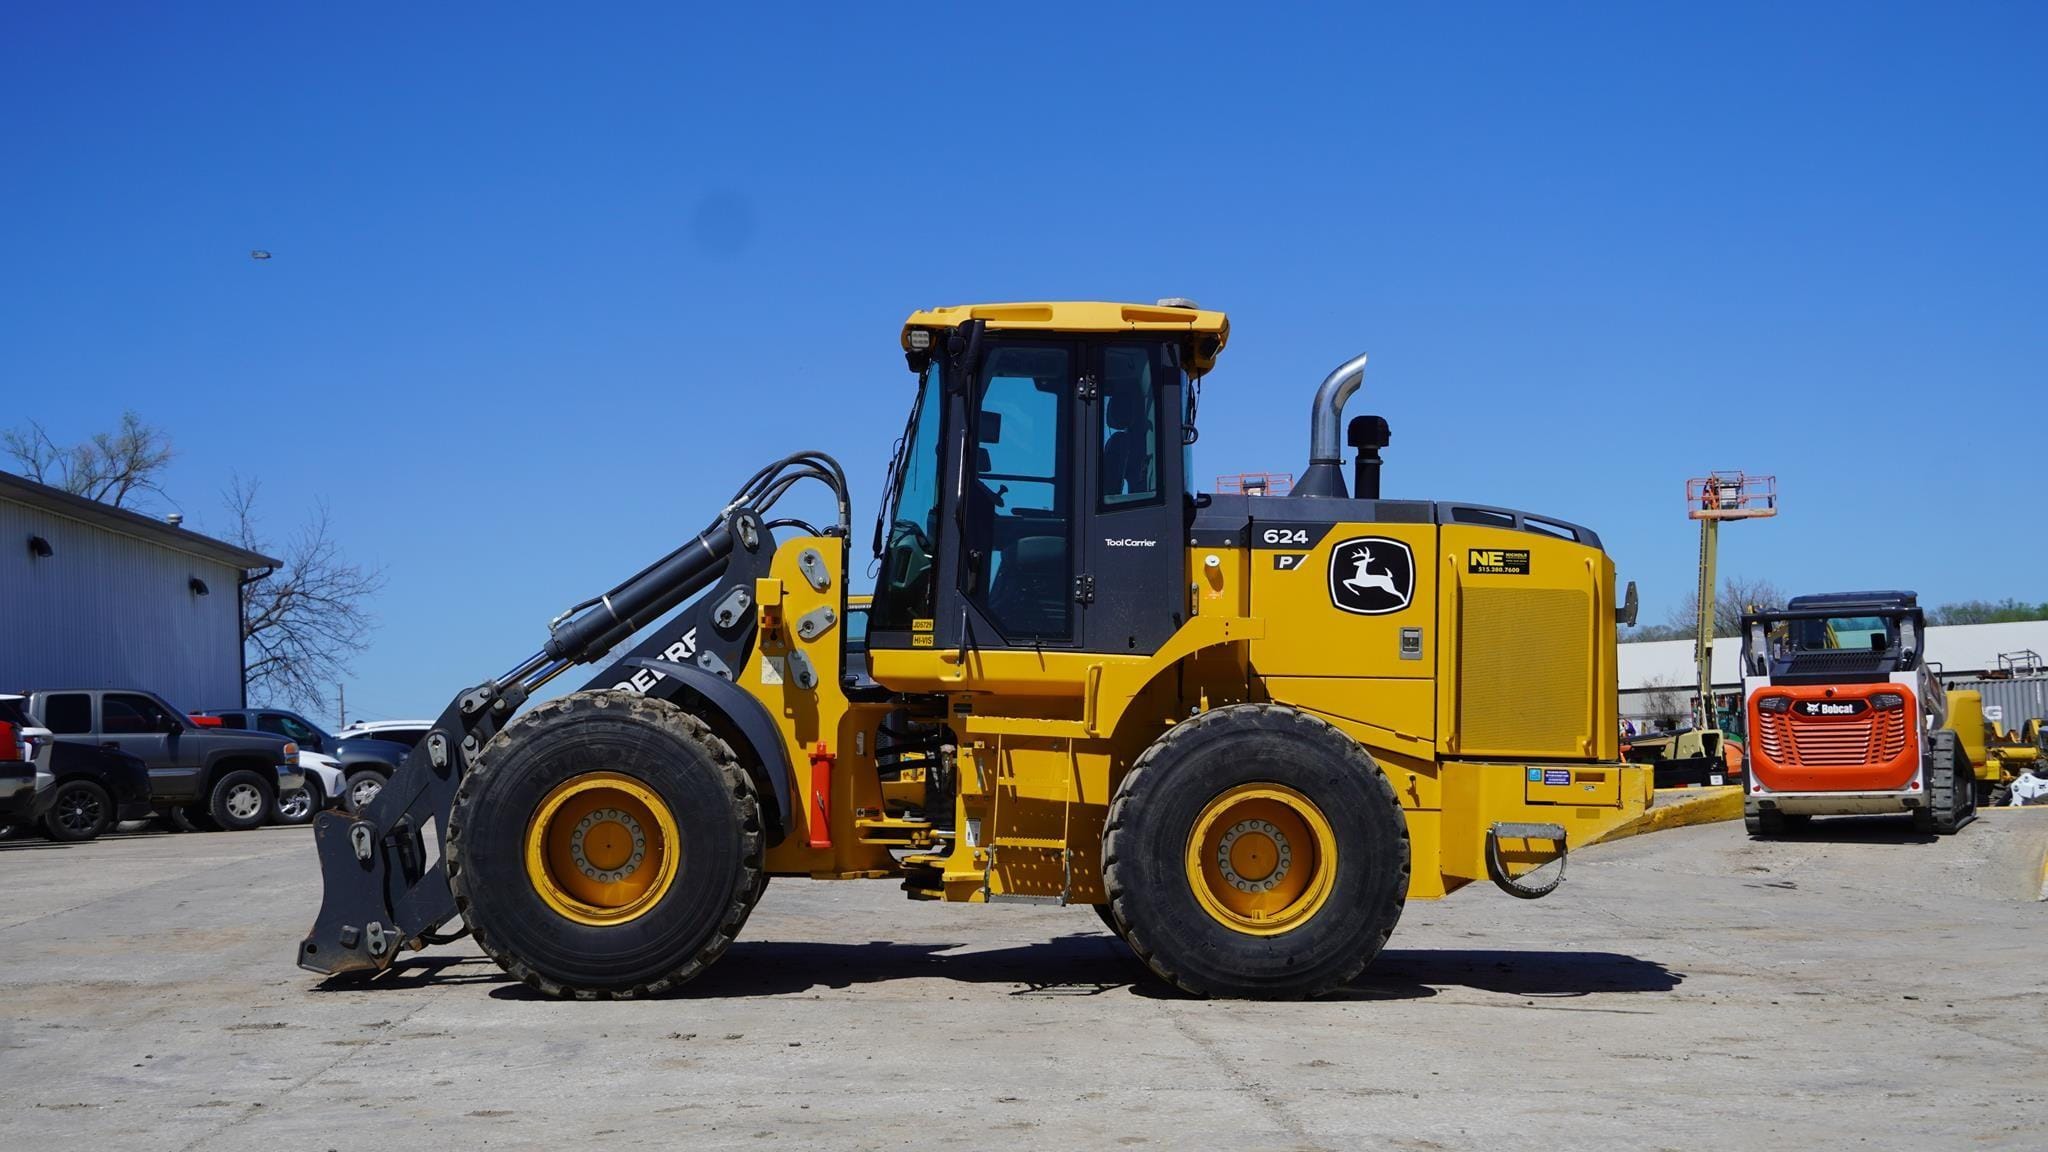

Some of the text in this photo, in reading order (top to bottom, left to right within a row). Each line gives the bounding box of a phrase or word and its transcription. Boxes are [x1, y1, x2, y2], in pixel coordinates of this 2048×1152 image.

[1105, 538, 1157, 546] Tool Carrier
[1263, 529, 1309, 544] 624
[1279, 556, 1293, 569] P
[1470, 551, 1504, 566] NE
[914, 635, 932, 645] HI-VIS
[1821, 703, 1855, 715] Bobcat
